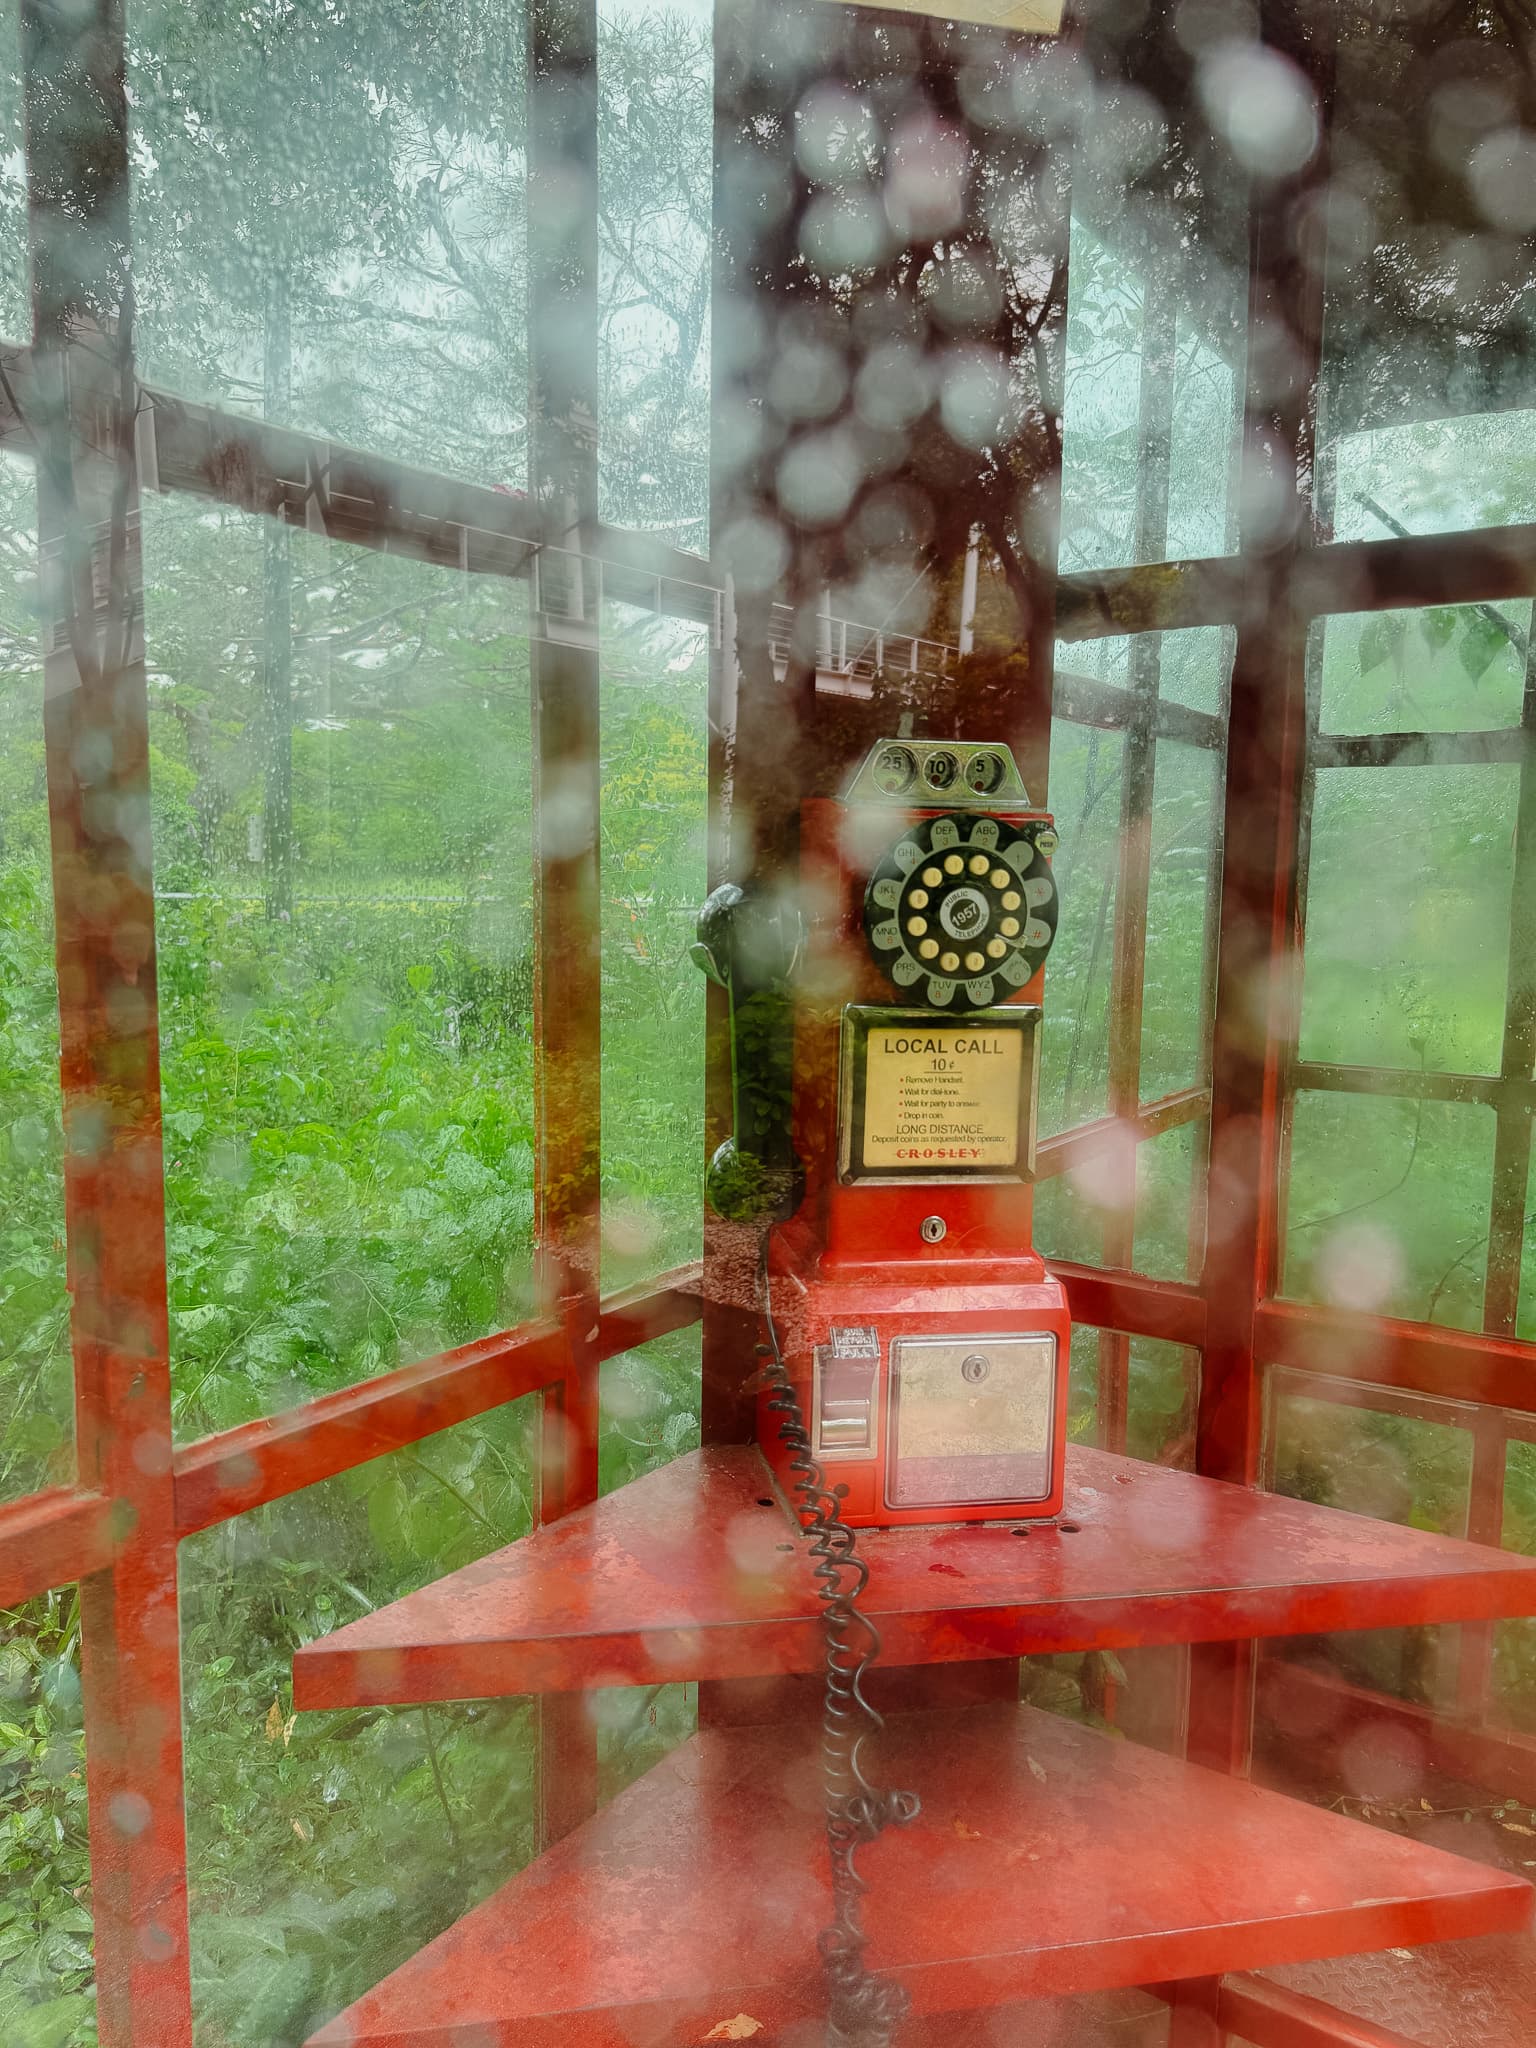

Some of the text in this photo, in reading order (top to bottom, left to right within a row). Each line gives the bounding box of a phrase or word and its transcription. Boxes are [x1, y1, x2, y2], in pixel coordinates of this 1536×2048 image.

[882, 755, 902, 770] 25
[929, 760, 946, 774] 10
[975, 759, 985, 773] 5
[935, 826, 955, 835] DEF
[976, 826, 997, 835] ABC
[942, 837, 949, 846] 3
[982, 837, 989, 846] 2
[898, 847, 916, 857] GHI
[879, 886, 896, 894] JKL
[951, 903, 977, 926] 1957
[876, 927, 898, 936] MNO
[895, 962, 916, 972] PRS
[933, 981, 952, 990] TUV
[967, 980, 991, 990] WYZ
[884, 1038, 1004, 1054] LOCAL CALL
[931, 1058, 946, 1071] 10
[905, 1075, 934, 1084] Remove
[904, 1087, 920, 1096] Wait
[920, 1087, 929, 1096] for
[929, 1100, 947, 1109] party
[903, 1111, 921, 1120] Drop
[921, 1111, 928, 1119] in
[896, 1124, 985, 1134] LONG DISTANCE
[871, 1134, 899, 1144] Deposit
[930, 1134, 966, 1144] requested
[966, 1134, 976, 1144] by
[896, 1148, 981, 1159] CROSLEY
